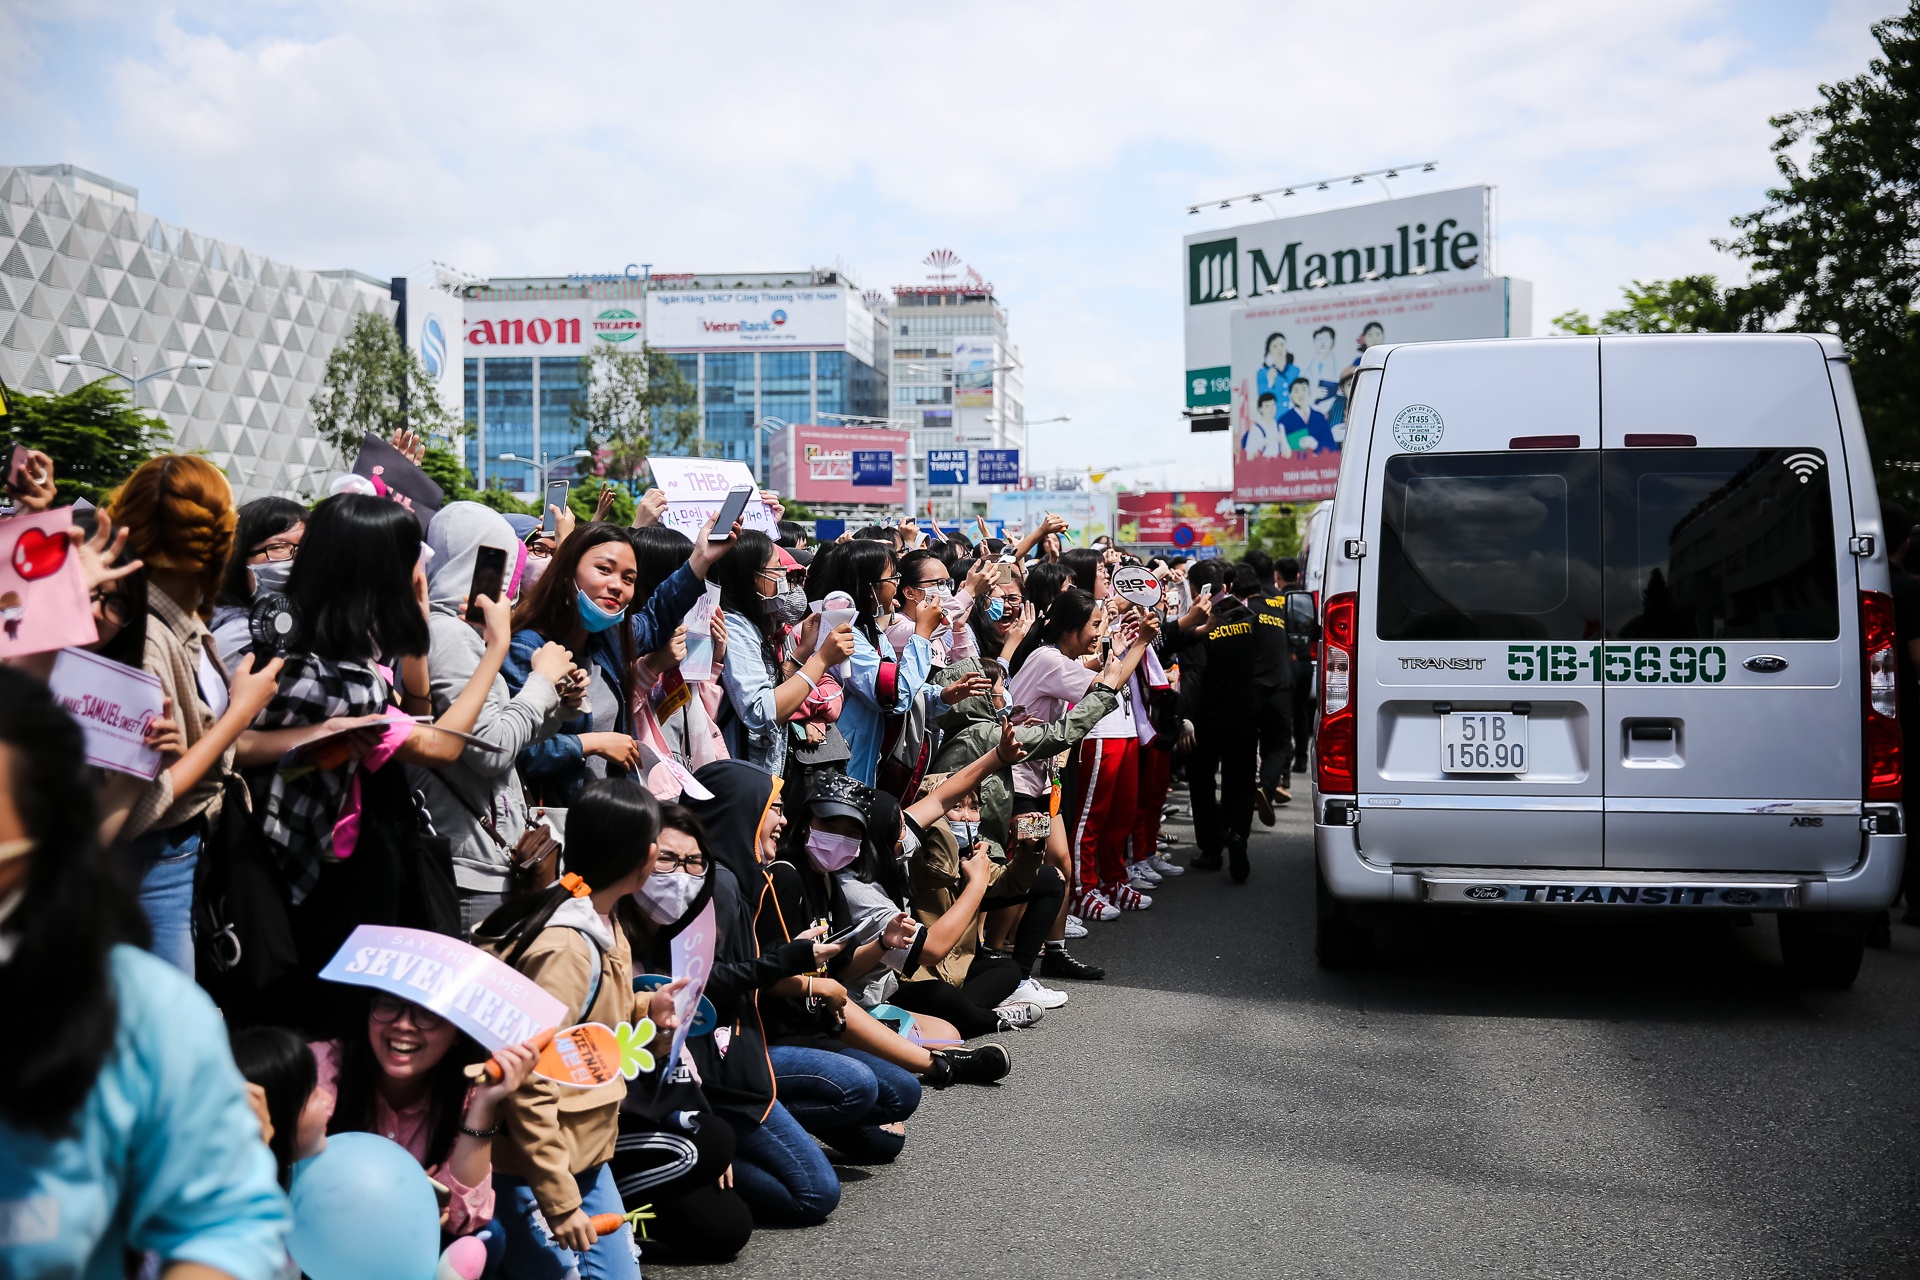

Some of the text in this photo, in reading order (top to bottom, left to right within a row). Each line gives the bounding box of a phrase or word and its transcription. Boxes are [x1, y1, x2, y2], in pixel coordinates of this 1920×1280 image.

[1247, 219, 1479, 298] Manulife
[464, 318, 582, 345] anon
[703, 321, 772, 333] VietinBank
[684, 473, 730, 492] THE8
[668, 506, 703, 529] 사무엘
[1116, 579, 1147, 593] 원우
[1398, 657, 1486, 670] TRANSIT
[1508, 646, 1726, 683] 51B-156.90
[1754, 658, 1780, 669] Ford
[118, 716, 142, 733] SWEET
[1463, 717, 1506, 741] 51B
[1448, 744, 1524, 768] 156.90
[1789, 817, 1823, 827] ABS
[1472, 888, 1500, 900] Ford
[1519, 885, 1715, 905] TRANSIT
[391, 935, 431, 950] SAY
[438, 945, 473, 965] THE
[345, 946, 542, 1046] SEVENTEEN
[554, 1037, 592, 1084] 세븐틴
[571, 1028, 607, 1084] VIETNAM
